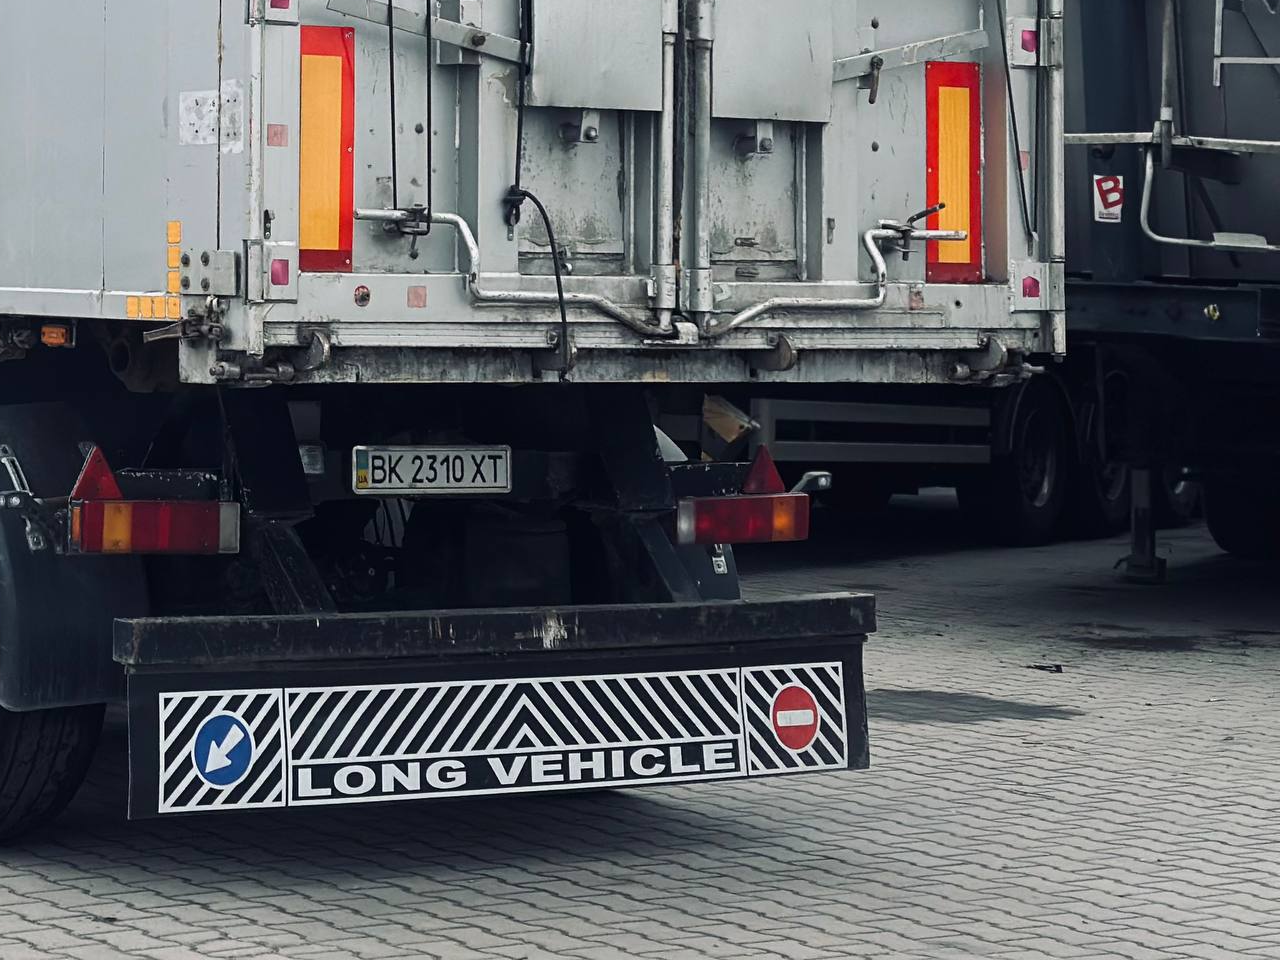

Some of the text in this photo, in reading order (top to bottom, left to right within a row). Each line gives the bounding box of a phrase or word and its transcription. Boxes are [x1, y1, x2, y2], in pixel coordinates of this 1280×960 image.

[1095, 176, 1125, 209] B
[371, 455, 503, 484] BK 2310 XT
[298, 743, 736, 797] LONG VEHICLE
